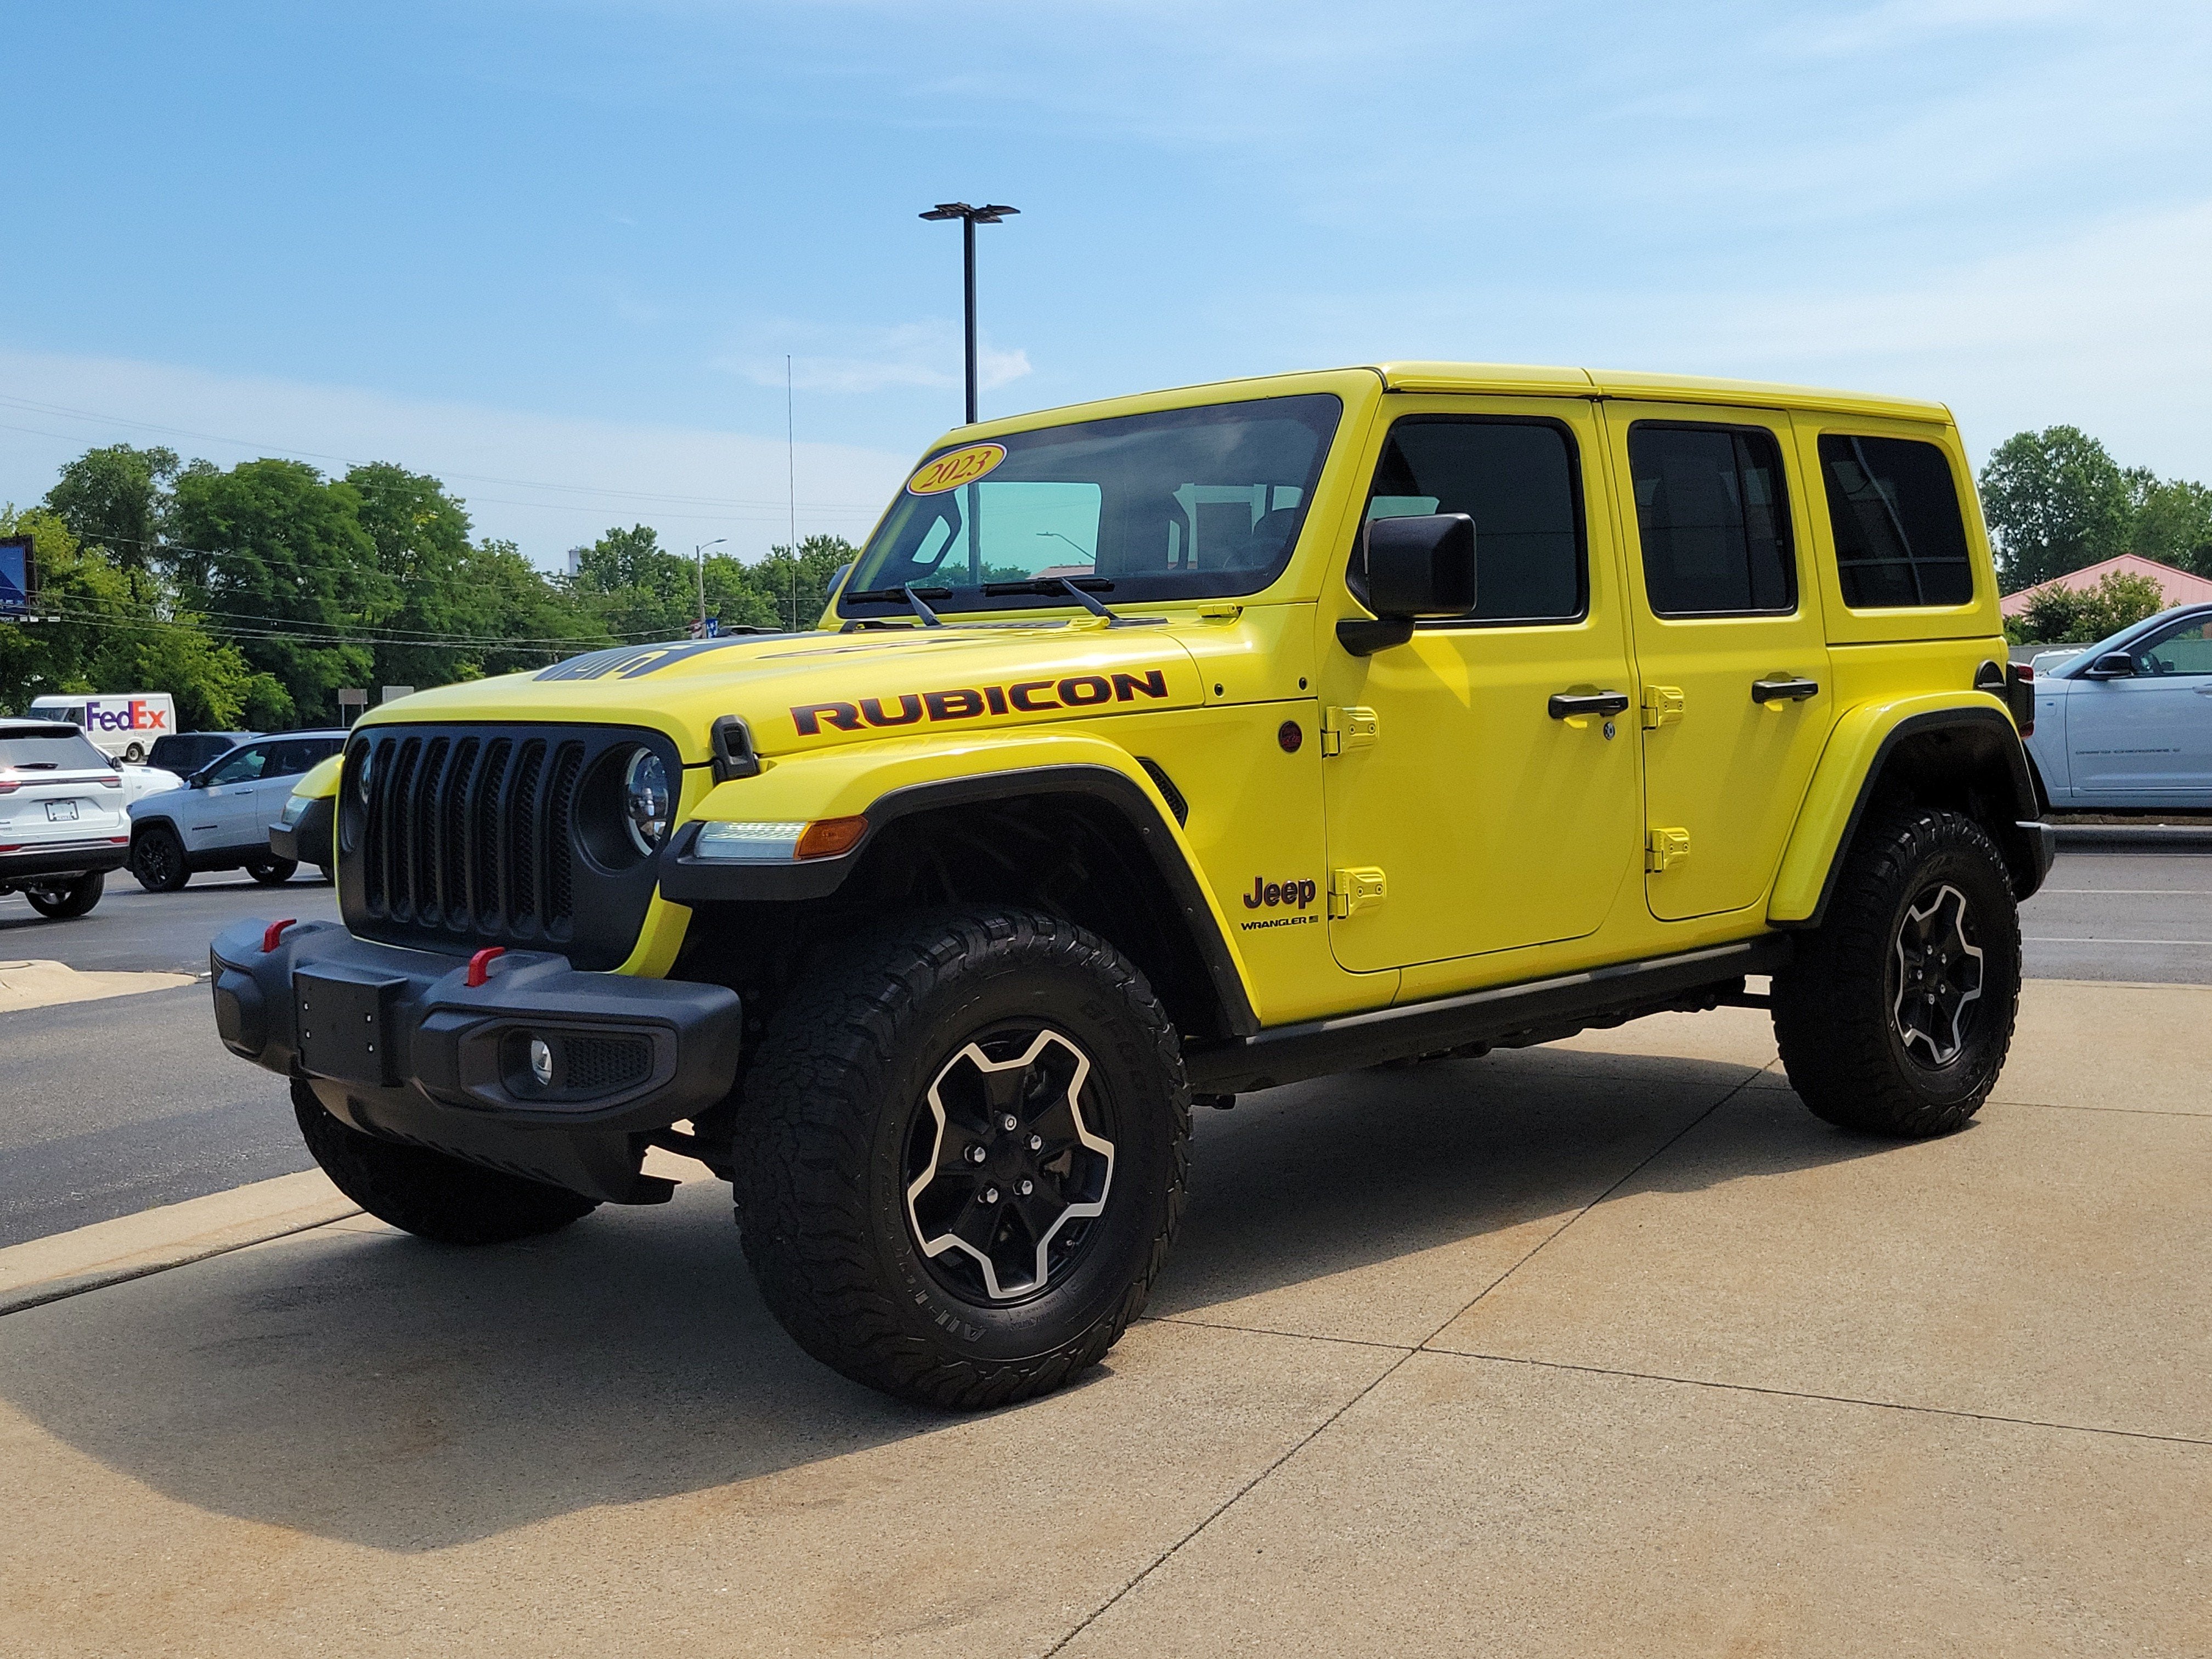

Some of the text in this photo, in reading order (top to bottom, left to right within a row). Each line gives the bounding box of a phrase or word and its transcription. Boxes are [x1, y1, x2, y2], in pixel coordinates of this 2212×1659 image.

[919, 450, 992, 489] 2023
[86, 699, 167, 732] FedEx
[789, 670, 1169, 736] RUBICON
[1243, 876, 1316, 910] Jeep
[1241, 917, 1307, 930] WRANGLER
